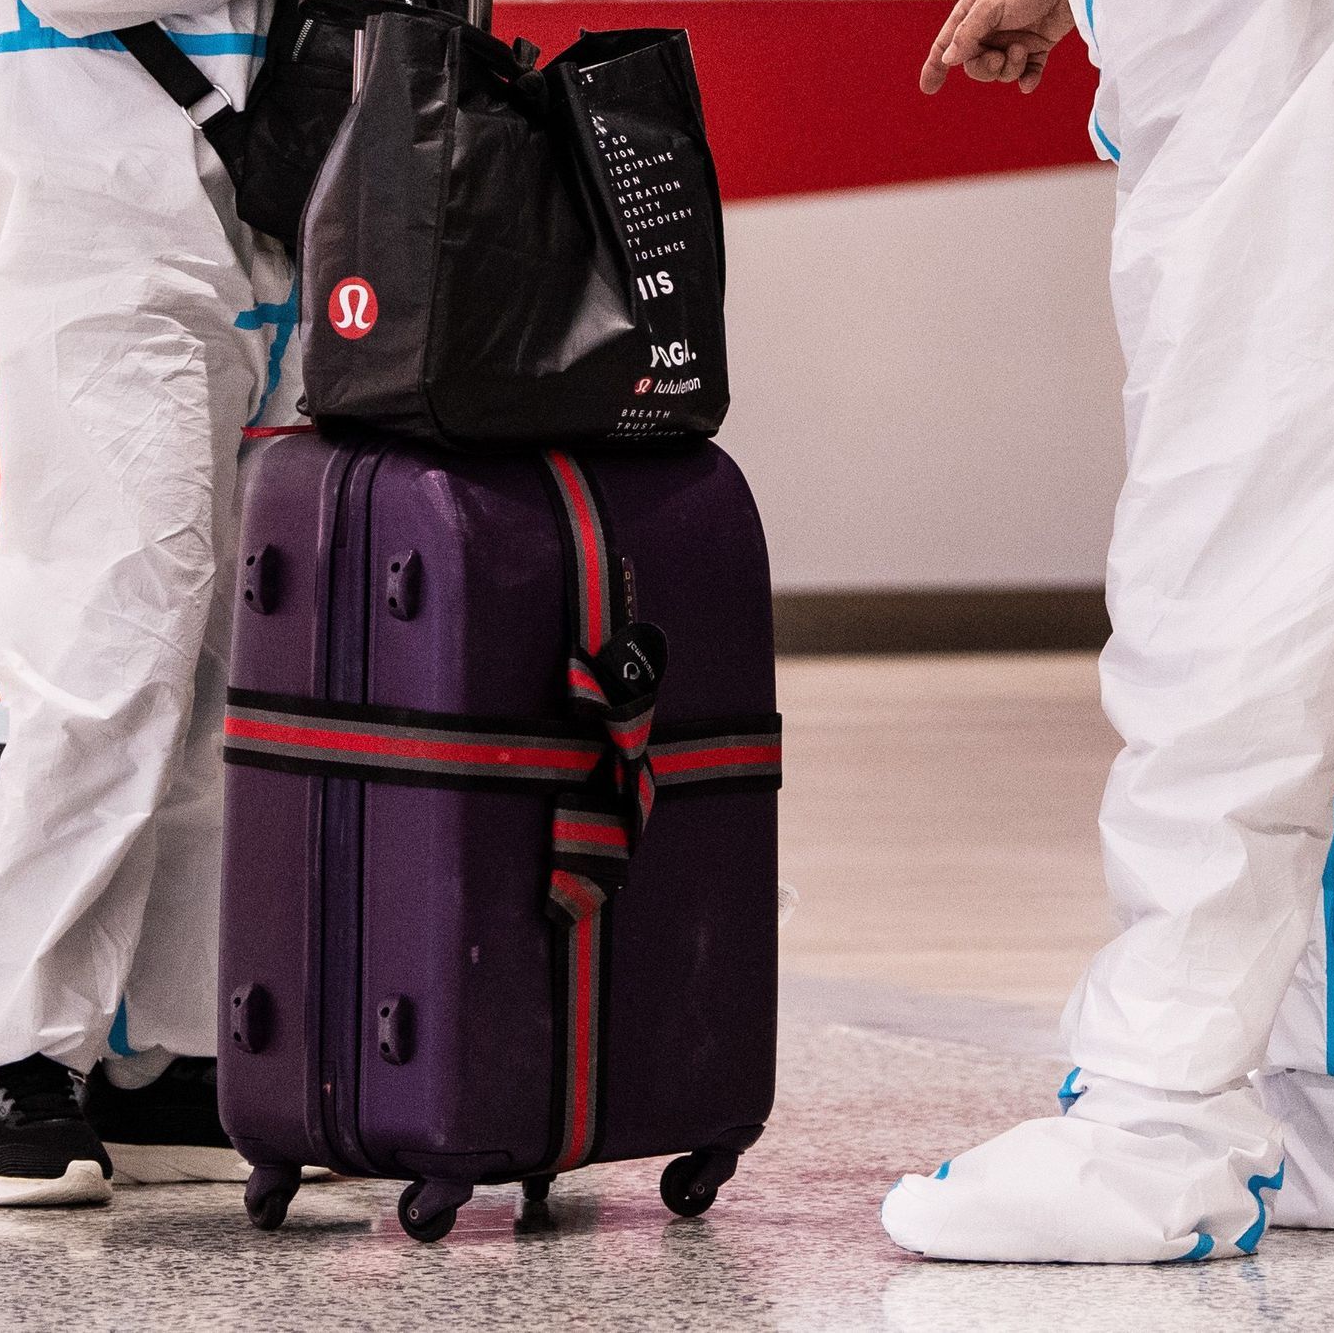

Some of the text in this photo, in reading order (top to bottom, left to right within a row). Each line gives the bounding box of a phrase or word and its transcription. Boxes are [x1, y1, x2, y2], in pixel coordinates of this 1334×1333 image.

[612, 135, 627, 145] GO
[605, 147, 635, 162] TION
[609, 152, 673, 177] ISCIPLINE
[614, 176, 640, 190] ION
[618, 180, 681, 205] NTRATION
[623, 200, 661, 218] OSITY
[626, 207, 692, 233] DISCOVERY
[627, 237, 640, 248] TY
[635, 240, 686, 262] IOLENCE
[654, 377, 701, 394] lululemon
[621, 408, 670, 418] BREATH
[616, 422, 656, 430] TRUST
